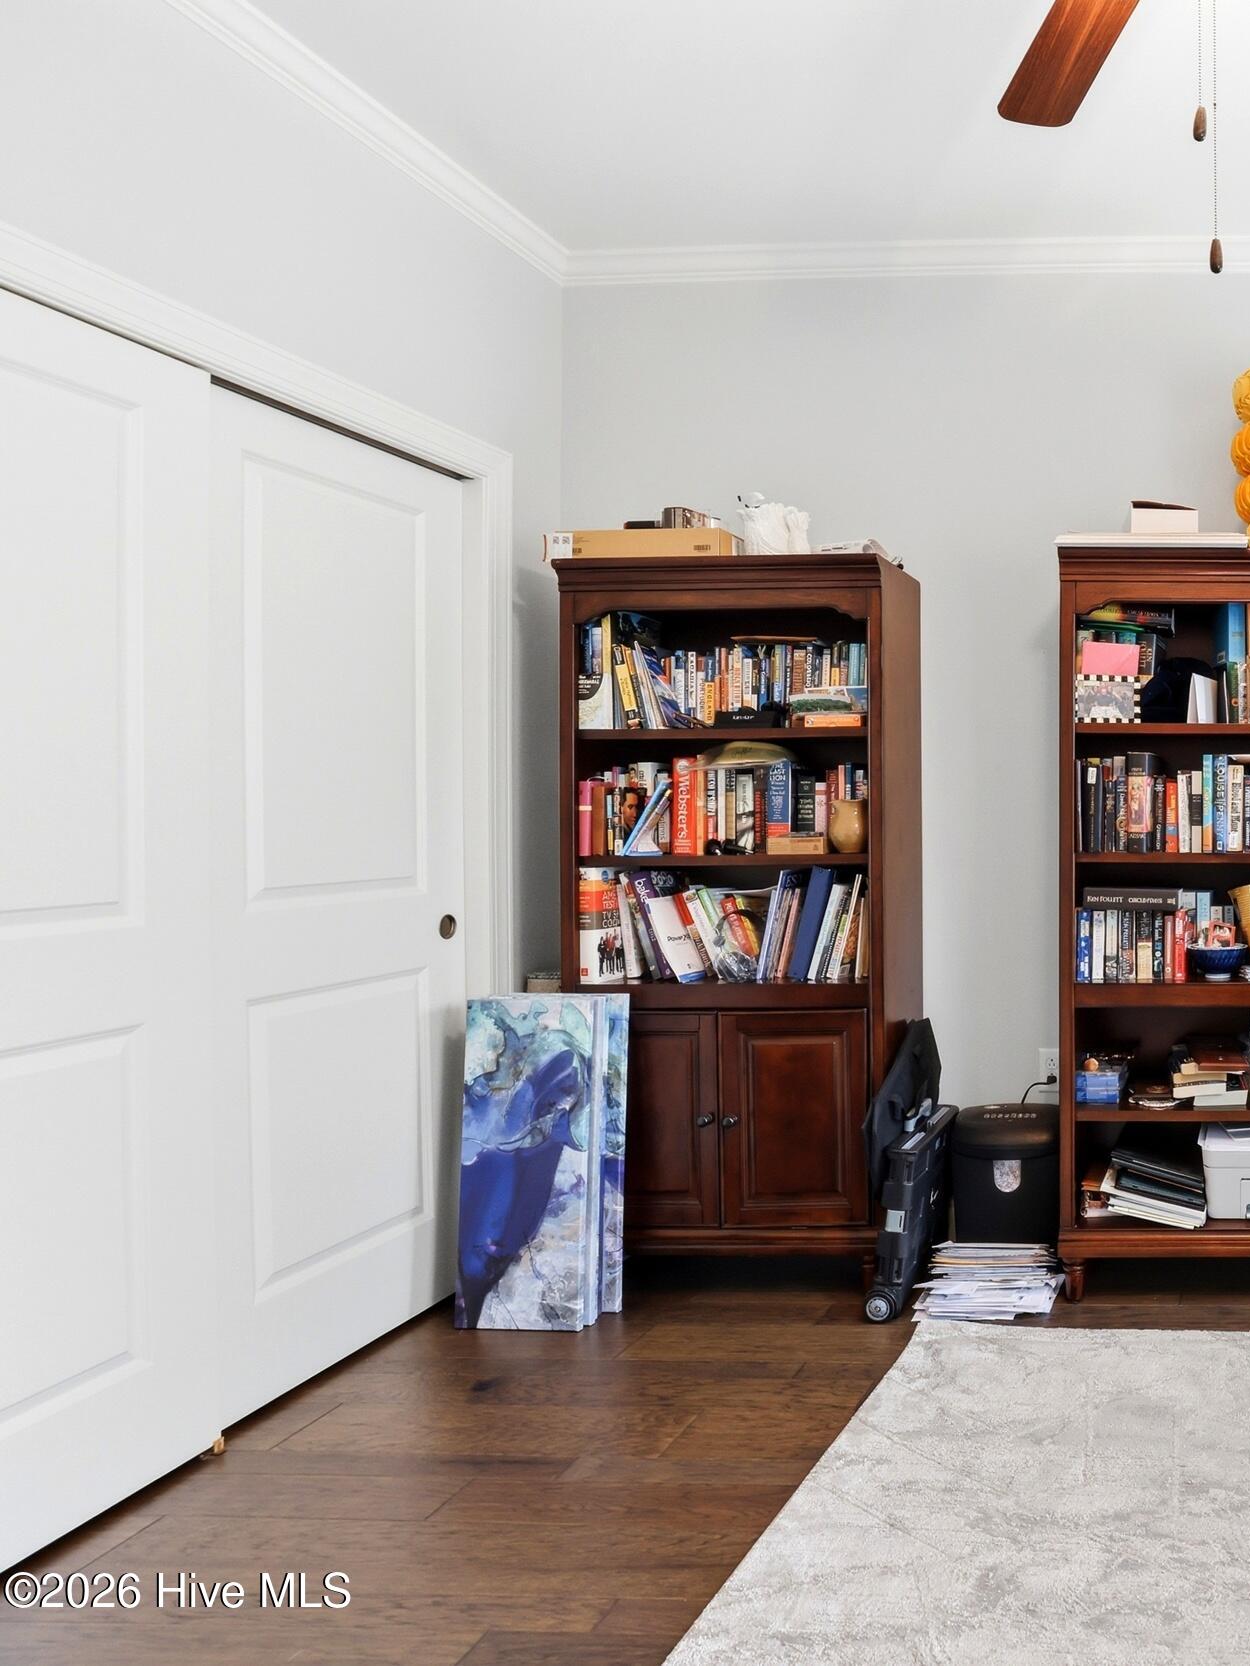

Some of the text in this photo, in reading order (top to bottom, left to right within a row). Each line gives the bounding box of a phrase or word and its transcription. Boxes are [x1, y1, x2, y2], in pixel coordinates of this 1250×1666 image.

[1216, 763, 1225, 798] LOUISE
[678, 774, 690, 839] Webster's
[635, 878, 648, 904] bake
